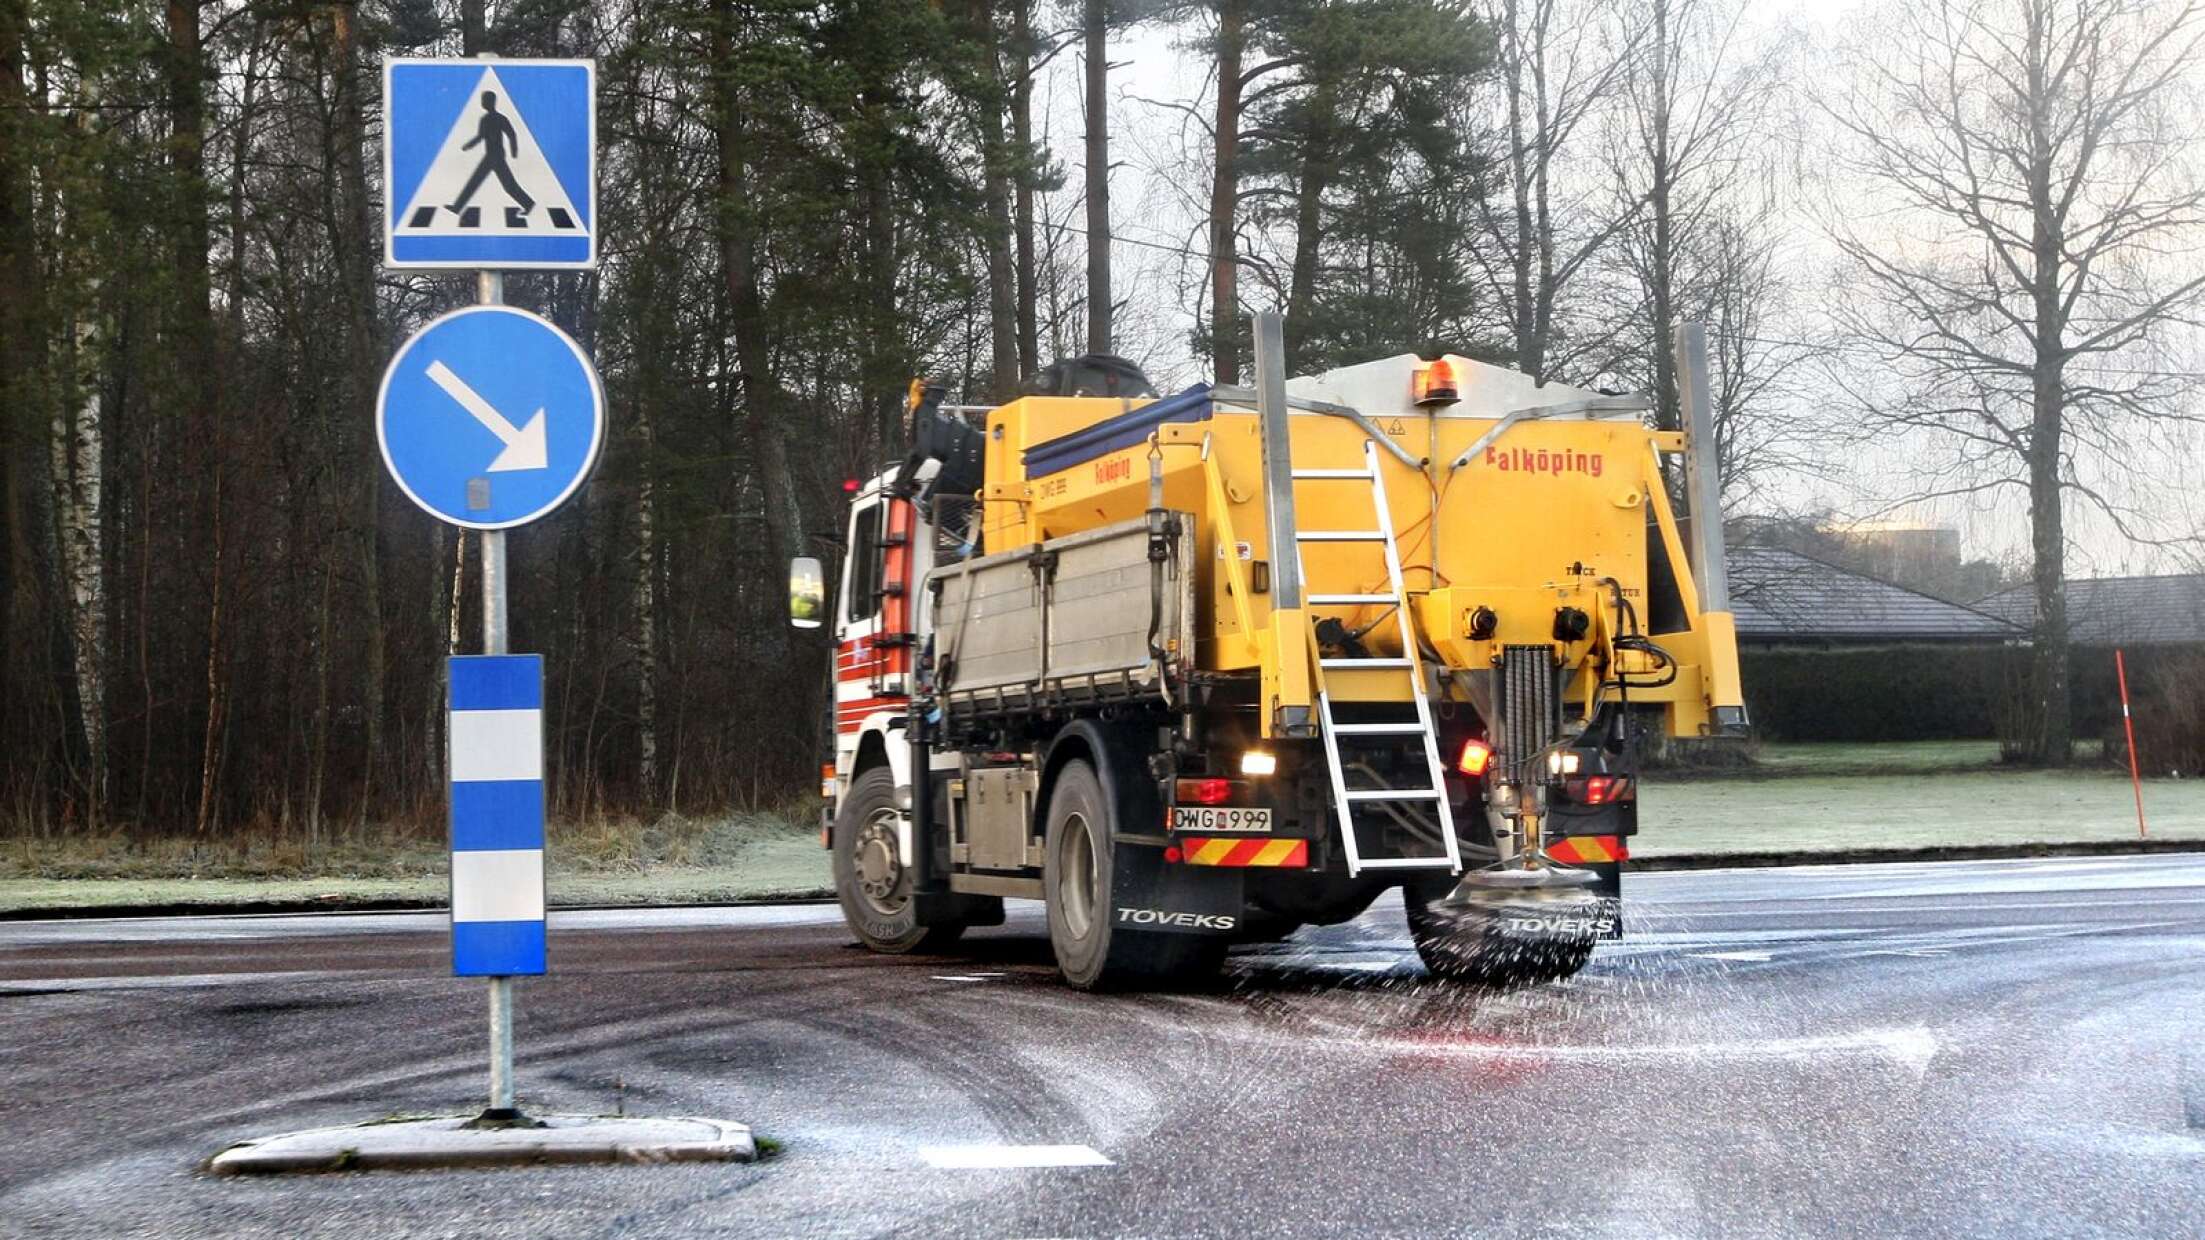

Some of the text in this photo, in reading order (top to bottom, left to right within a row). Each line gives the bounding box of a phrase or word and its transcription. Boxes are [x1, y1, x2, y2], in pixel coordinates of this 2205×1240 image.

[1486, 446, 1603, 478] Falköping
[1229, 810, 1269, 829] 999
[1117, 907, 1236, 930] TOVEKS
[1508, 917, 1615, 934] TOVEKS
